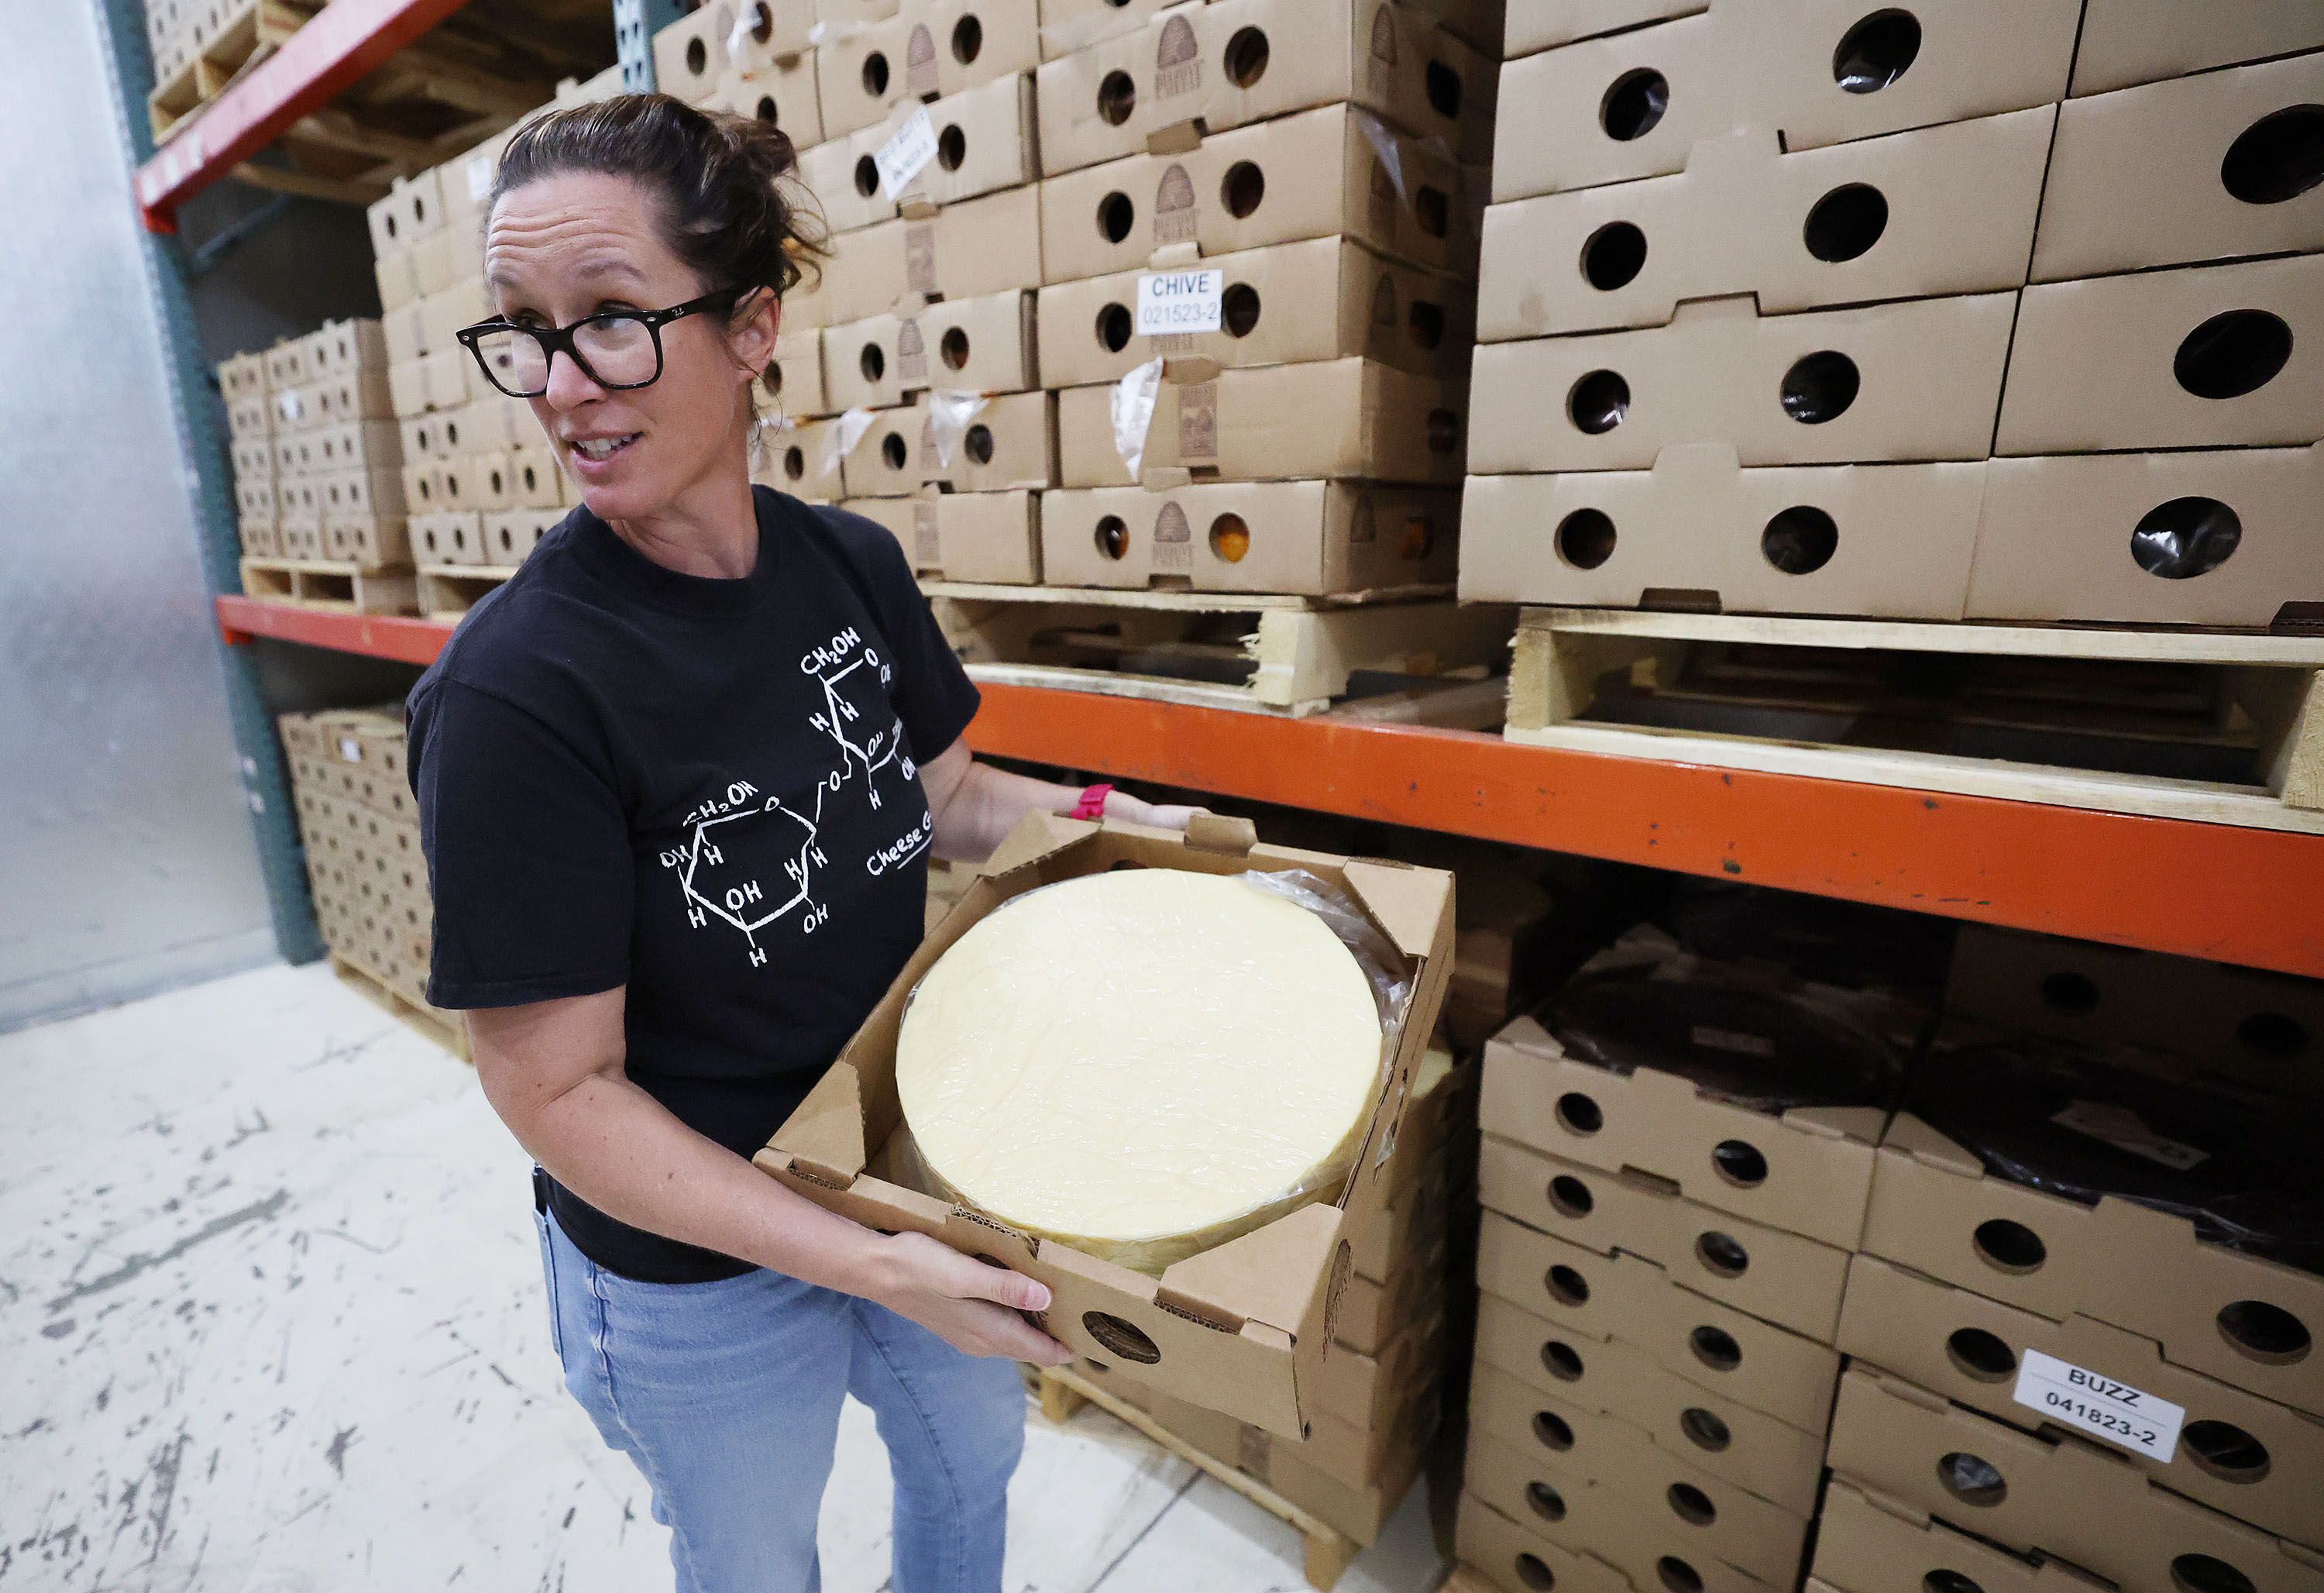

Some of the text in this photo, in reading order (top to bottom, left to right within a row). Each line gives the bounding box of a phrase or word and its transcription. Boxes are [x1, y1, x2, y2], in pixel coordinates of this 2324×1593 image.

[1153, 274, 1209, 297] CHIVE
[1144, 301, 1218, 324] 021523-2
[808, 712, 830, 732] H
[839, 701, 860, 722] H
[868, 789, 882, 810] H
[703, 845, 724, 866] H
[810, 846, 829, 869] H
[866, 827, 923, 876] Cheese
[783, 858, 803, 881] H
[725, 879, 763, 911] OH
[687, 906, 707, 929] H
[803, 903, 829, 934] OH
[748, 947, 768, 968] H
[2069, 1369, 2140, 1408] BUZZ
[2046, 1392, 2157, 1447] 041823-2
